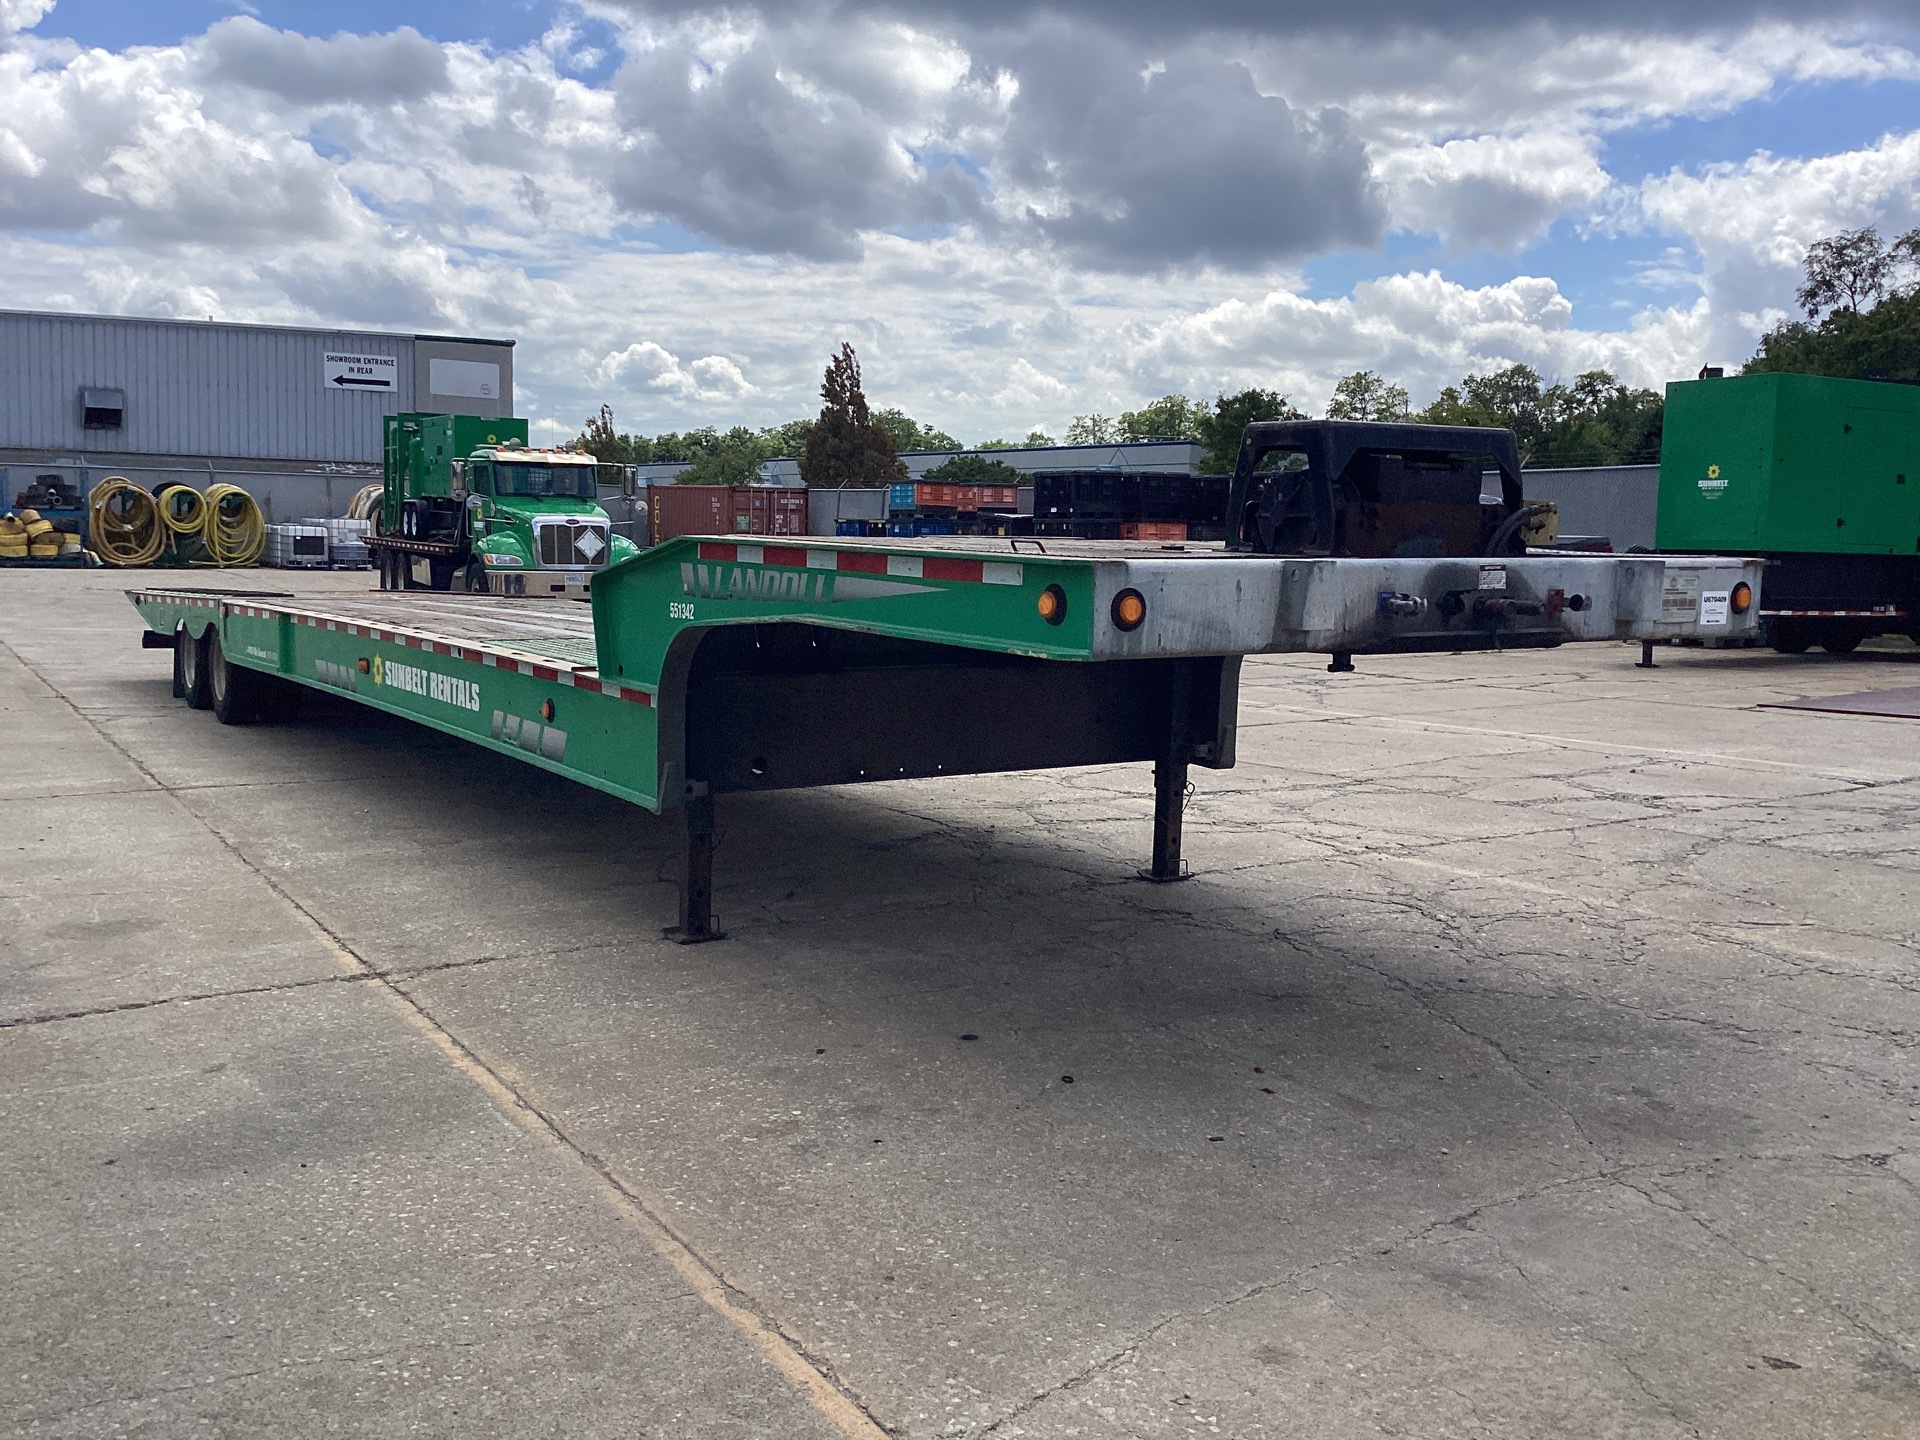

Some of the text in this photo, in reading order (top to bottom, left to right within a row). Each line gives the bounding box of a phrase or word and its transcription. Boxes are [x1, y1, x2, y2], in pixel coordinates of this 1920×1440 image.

[326, 354, 395, 367] SHOWROOM ENTRANCE
[348, 366, 373, 375] IN REAR
[1697, 479, 1729, 487] SUNBELT
[714, 566, 826, 602] LANDOLL
[669, 602, 695, 619] 551342
[385, 660, 480, 712] SUNBELT RENTALS
